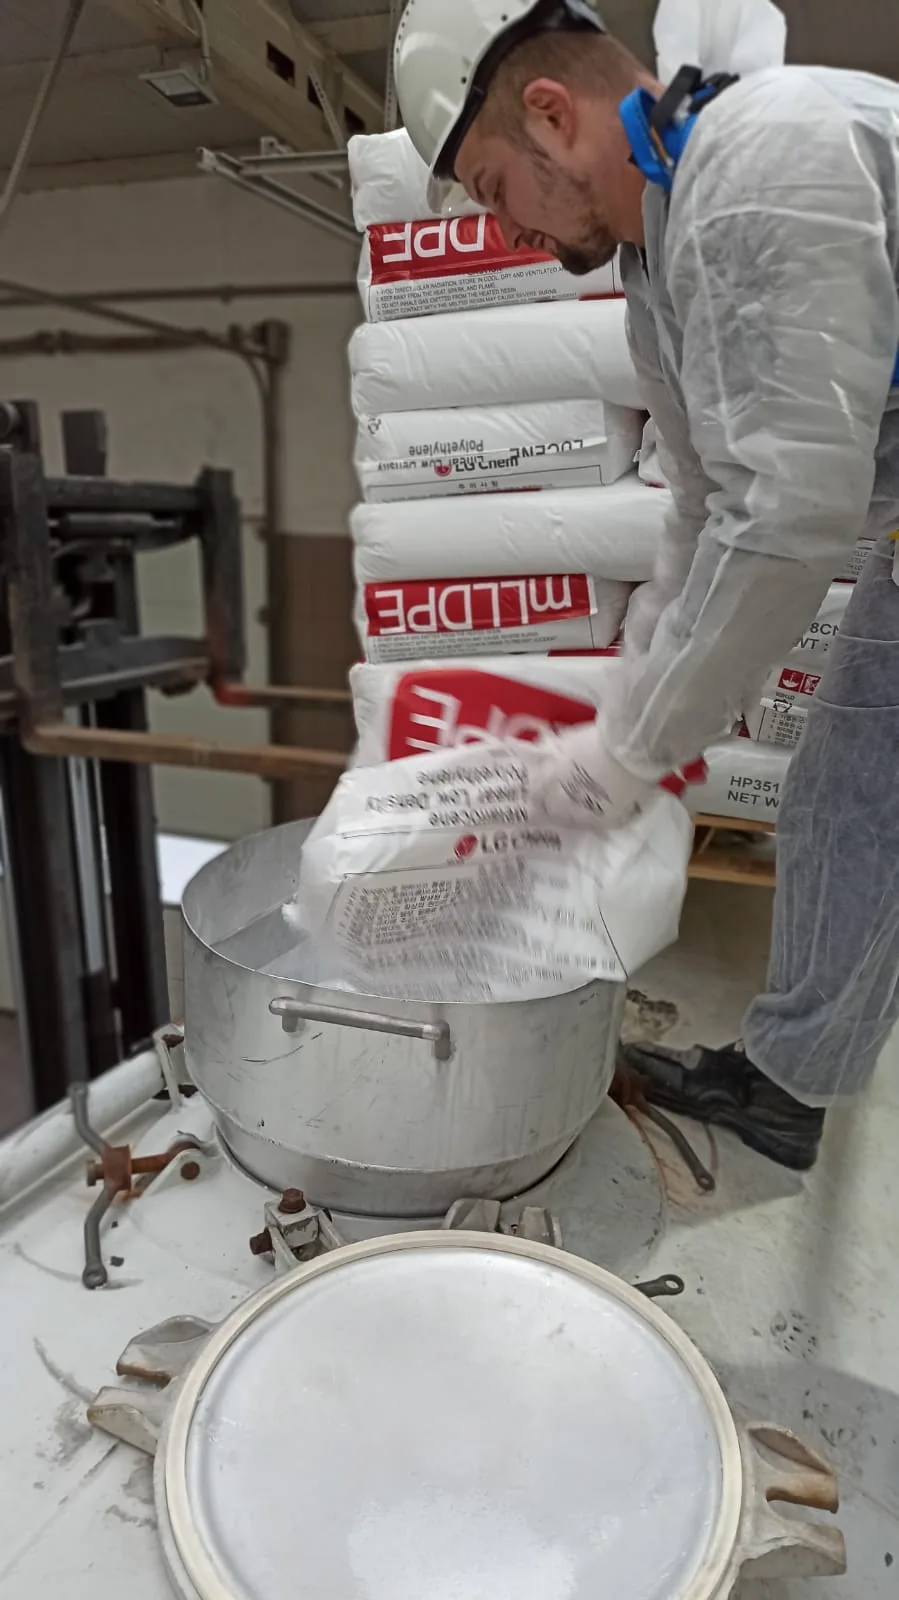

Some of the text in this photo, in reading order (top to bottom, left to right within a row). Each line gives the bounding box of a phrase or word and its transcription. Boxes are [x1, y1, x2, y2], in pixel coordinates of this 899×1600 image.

[408, 438, 485, 458] Polyethylene
[375, 576, 573, 635] mLLDPE
[730, 775, 779, 794] HP351
[728, 790, 761, 805] NET
